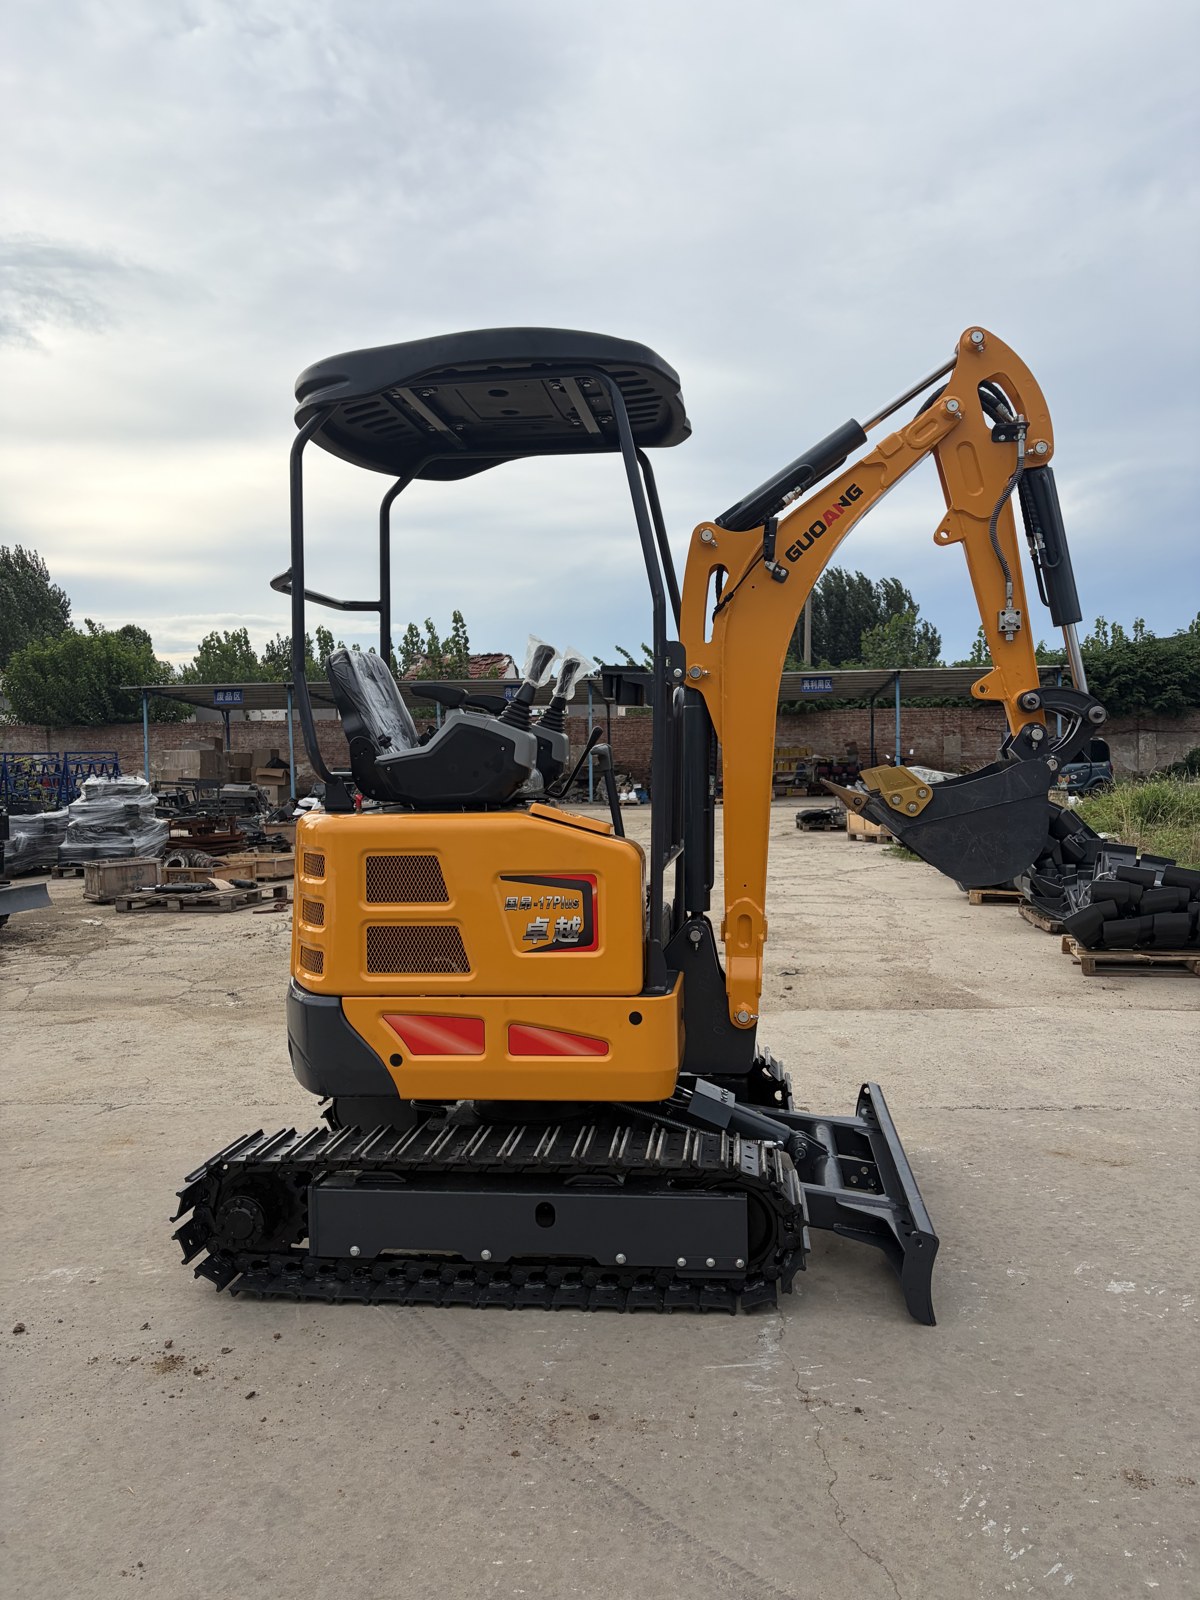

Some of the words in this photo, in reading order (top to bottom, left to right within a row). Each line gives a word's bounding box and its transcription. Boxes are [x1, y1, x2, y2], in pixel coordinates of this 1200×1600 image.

[785, 483, 864, 562] GUOANG
[803, 679, 832, 690] 再利用区
[522, 916, 582, 944] 卓越
